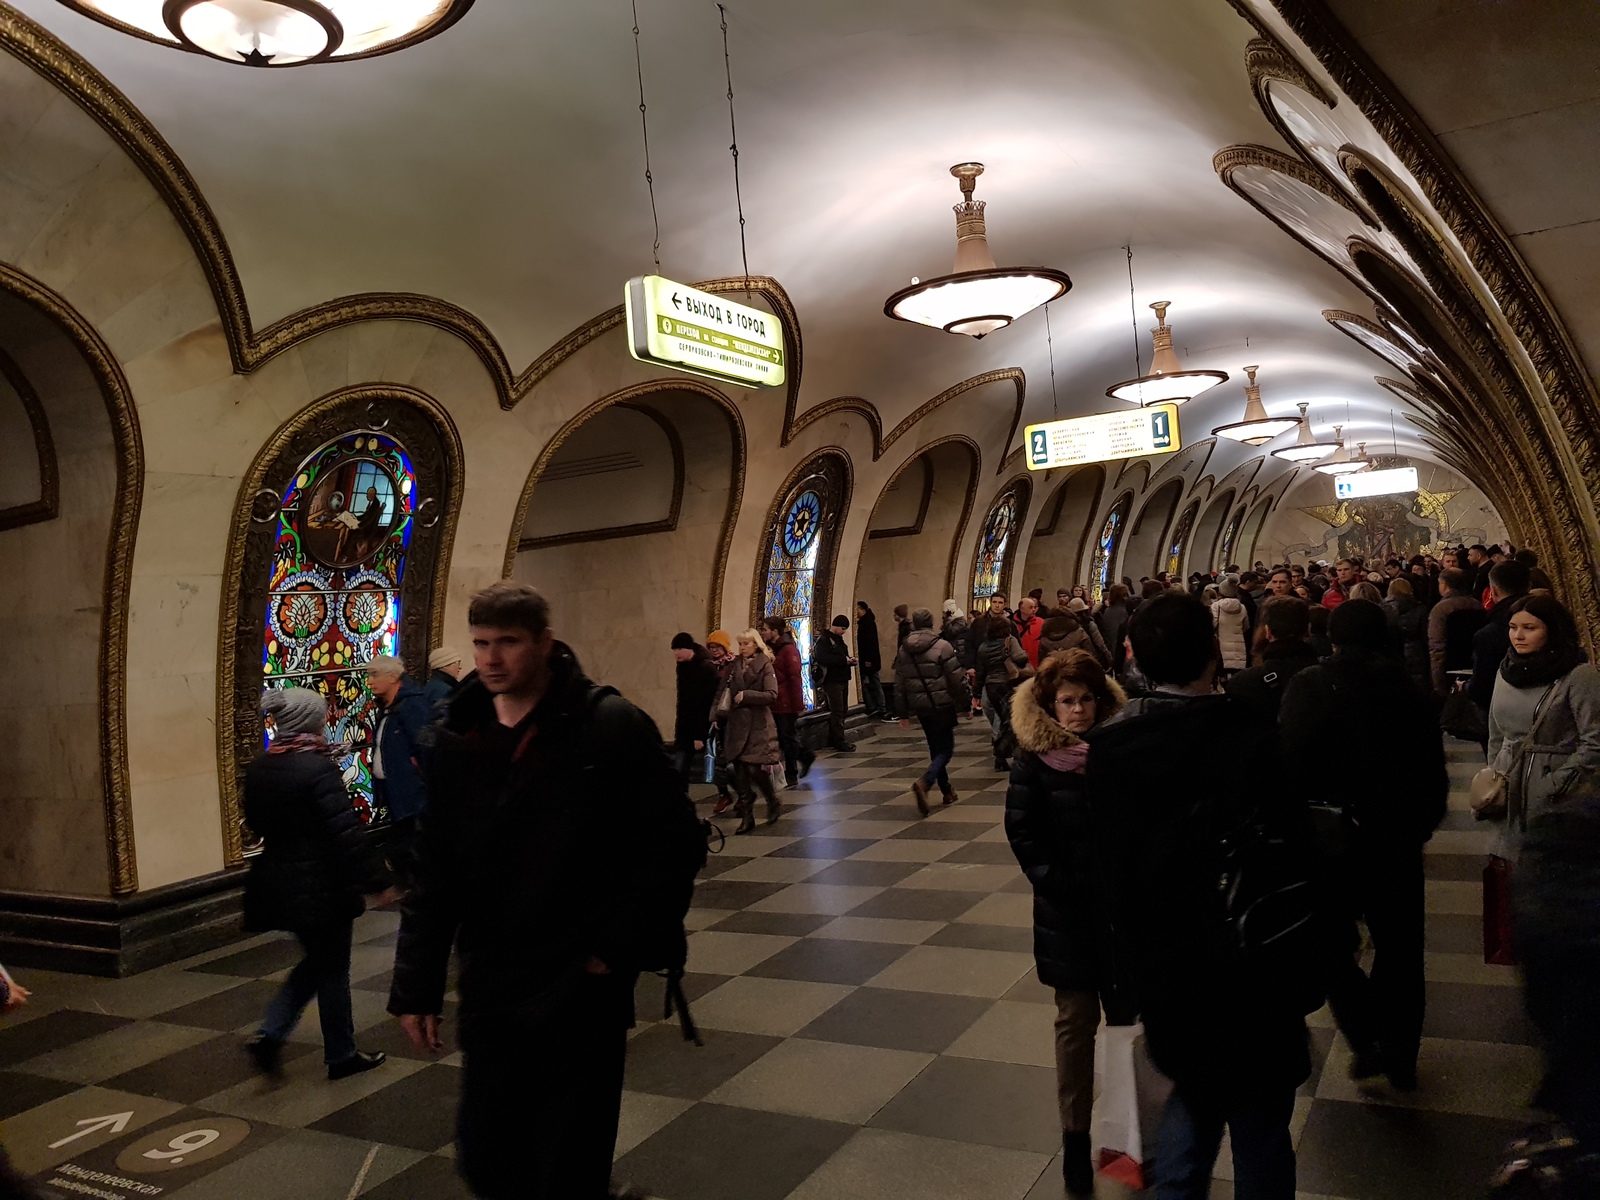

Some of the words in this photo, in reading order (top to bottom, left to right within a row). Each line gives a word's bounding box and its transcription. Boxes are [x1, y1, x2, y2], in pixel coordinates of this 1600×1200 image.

[686, 297, 723, 324] ВЫХОД
[726, 309, 733, 325] В
[737, 313, 766, 338] ГОРОД
[1154, 416, 1163, 435] 1
[1034, 434, 1043, 453] 2
[55, 1163, 164, 1196] Менделеевская
